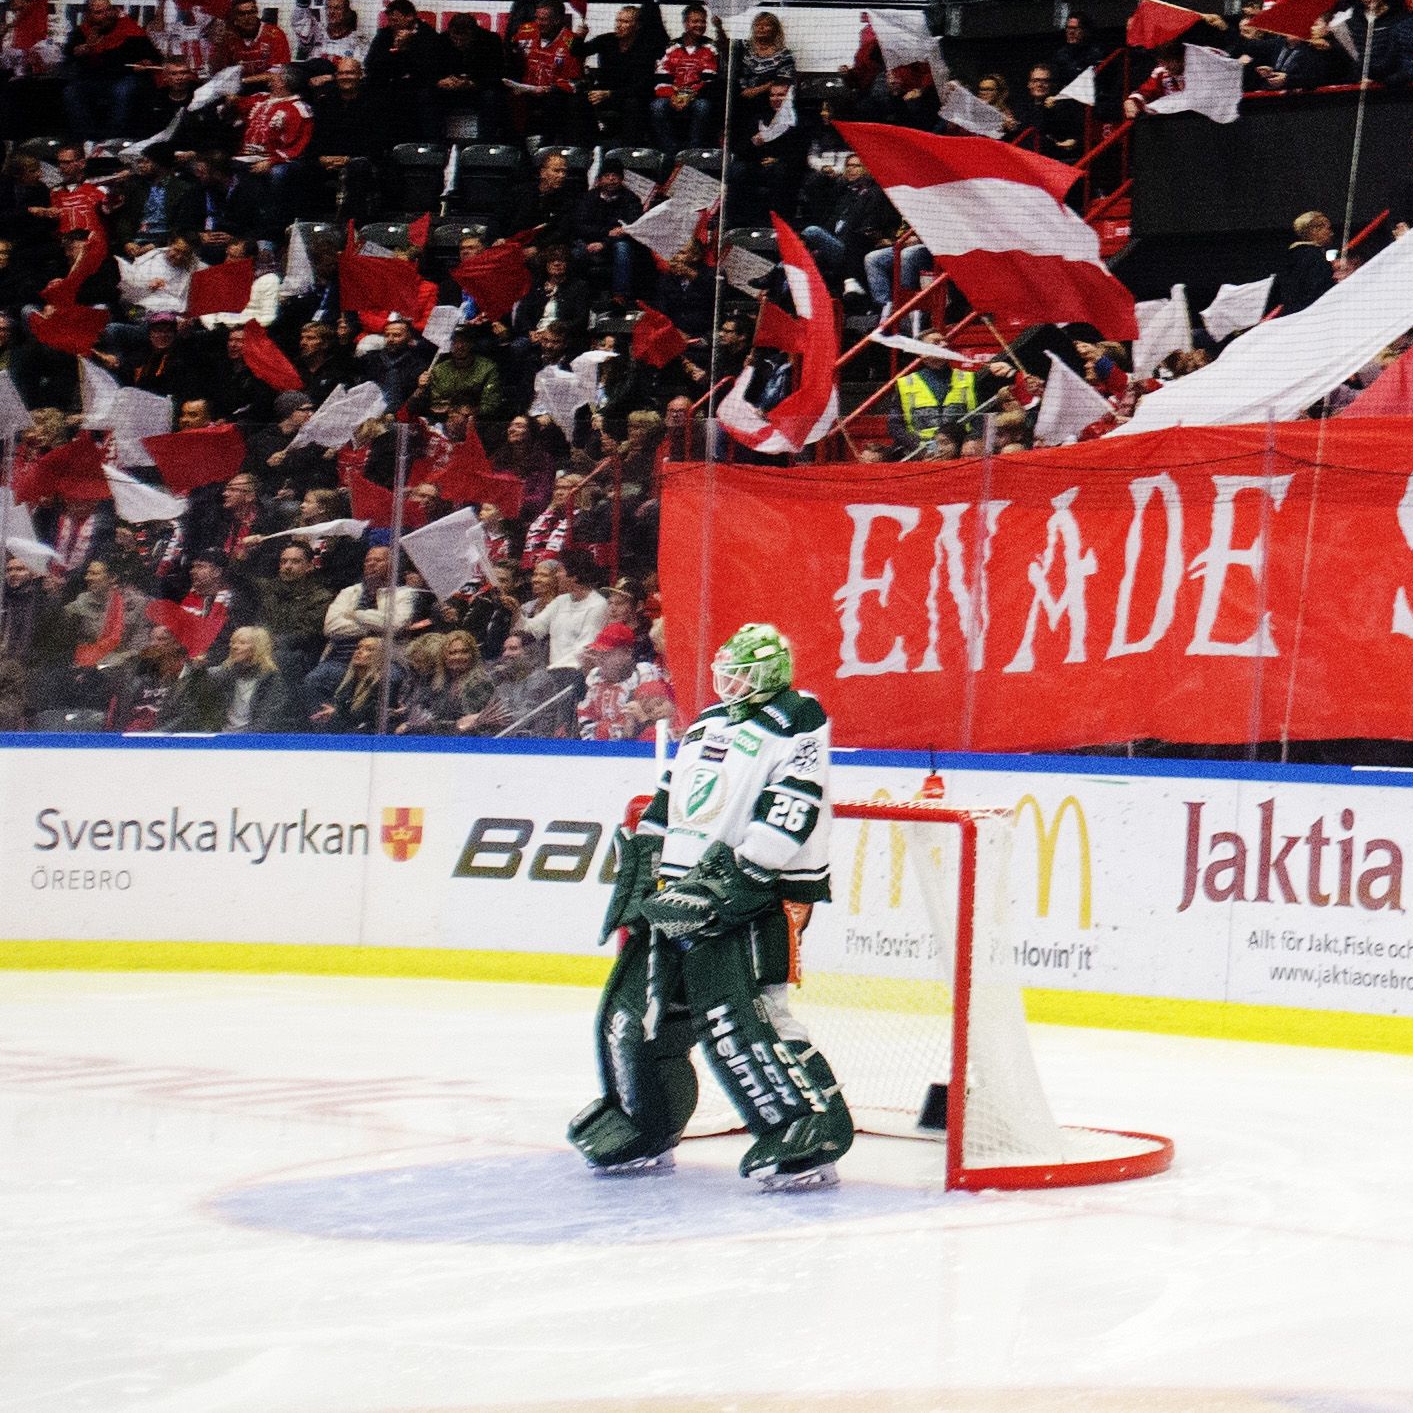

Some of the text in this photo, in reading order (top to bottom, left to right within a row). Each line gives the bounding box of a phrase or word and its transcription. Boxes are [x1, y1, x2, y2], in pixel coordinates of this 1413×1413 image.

[834, 472, 1297, 679] ENADE
[33, 807, 371, 865] Svenska kyrkan
[766, 794, 809, 833] 26
[30, 866, 133, 893] ÖREBRO
[1176, 797, 1406, 914] Jaktia
[1247, 929, 1276, 950] Allt
[1280, 930, 1304, 952] för
